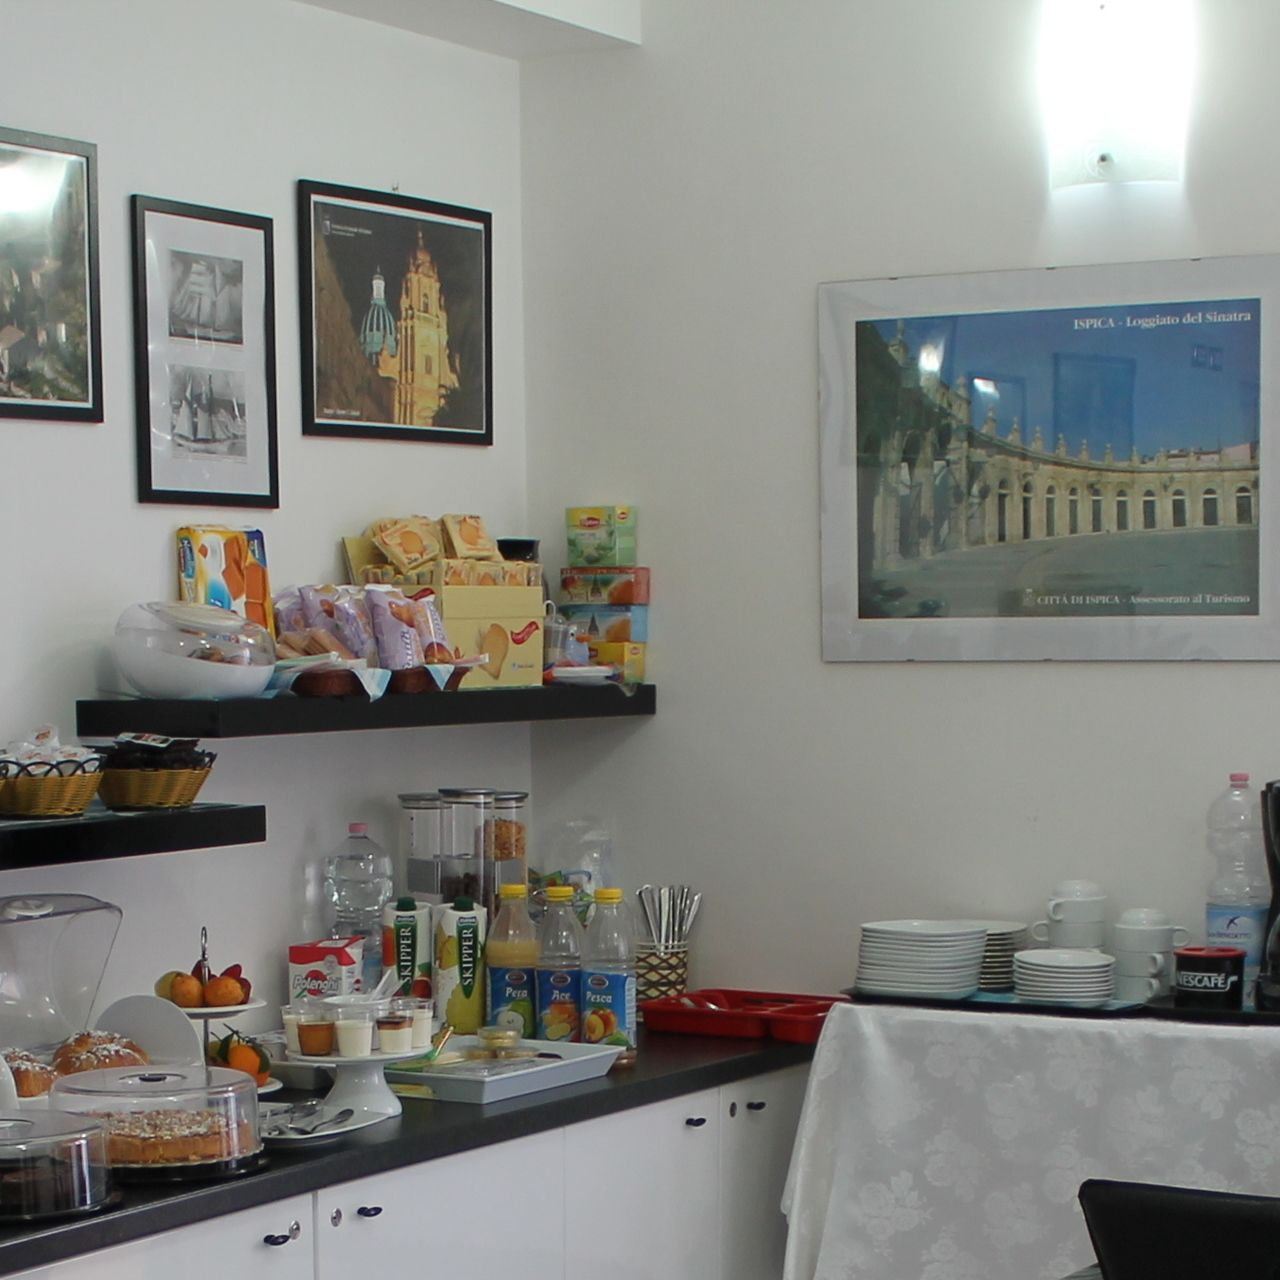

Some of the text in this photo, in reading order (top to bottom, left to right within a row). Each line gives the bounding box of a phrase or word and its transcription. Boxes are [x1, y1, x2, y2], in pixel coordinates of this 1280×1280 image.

[1074, 318, 1115, 330] ISPICA
[1126, 316, 1179, 330] Loggiato
[1182, 312, 1202, 325] del
[1205, 311, 1252, 323] Sinatra
[1071, 595, 1083, 605] DI
[1205, 593, 1251, 604] Turismo
[400, 926, 412, 983] SKIPPER
[462, 927, 474, 986] SKIPPER
[293, 975, 339, 993] Polenghi
[505, 986, 529, 999] Pera
[552, 989, 571, 1000] Ace
[585, 991, 613, 1003] Pesca
